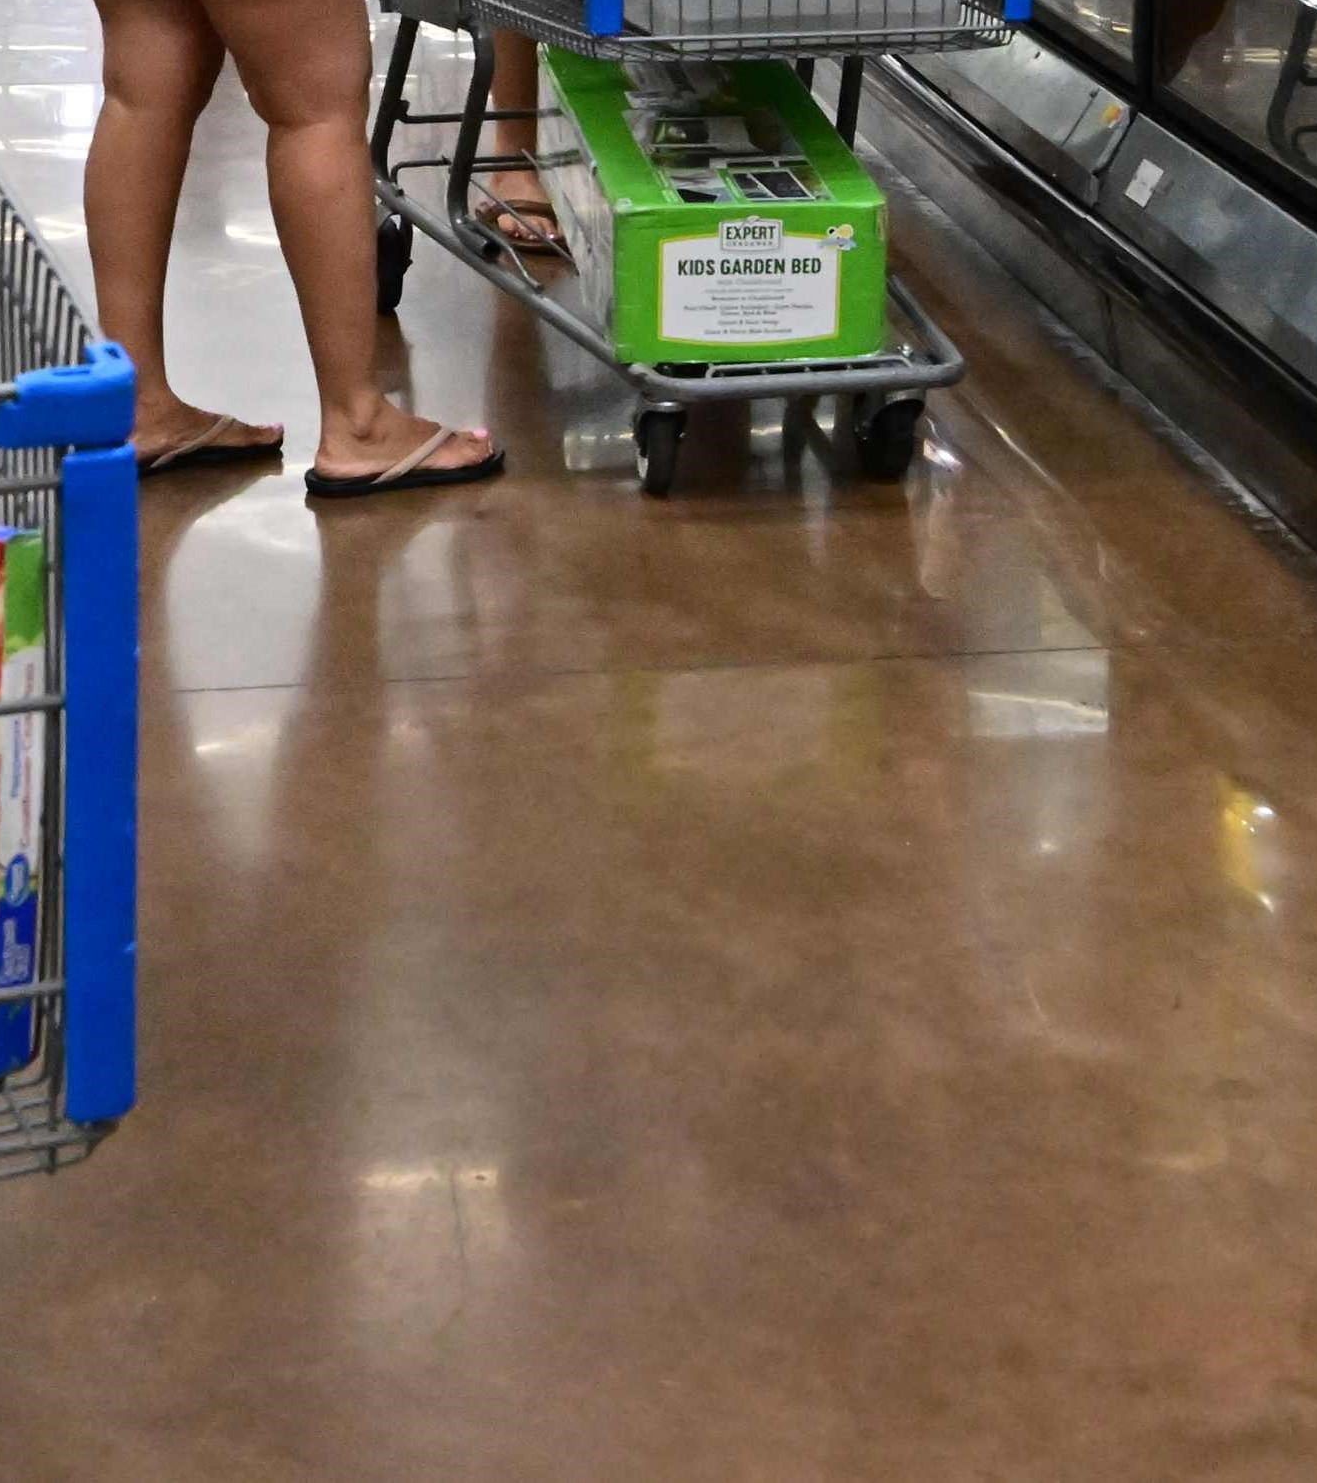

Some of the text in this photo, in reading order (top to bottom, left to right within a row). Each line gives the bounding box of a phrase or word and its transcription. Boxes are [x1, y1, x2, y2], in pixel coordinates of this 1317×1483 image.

[726, 226, 776, 240] EXPERT
[678, 257, 822, 276] KIDS GARDEN BED
